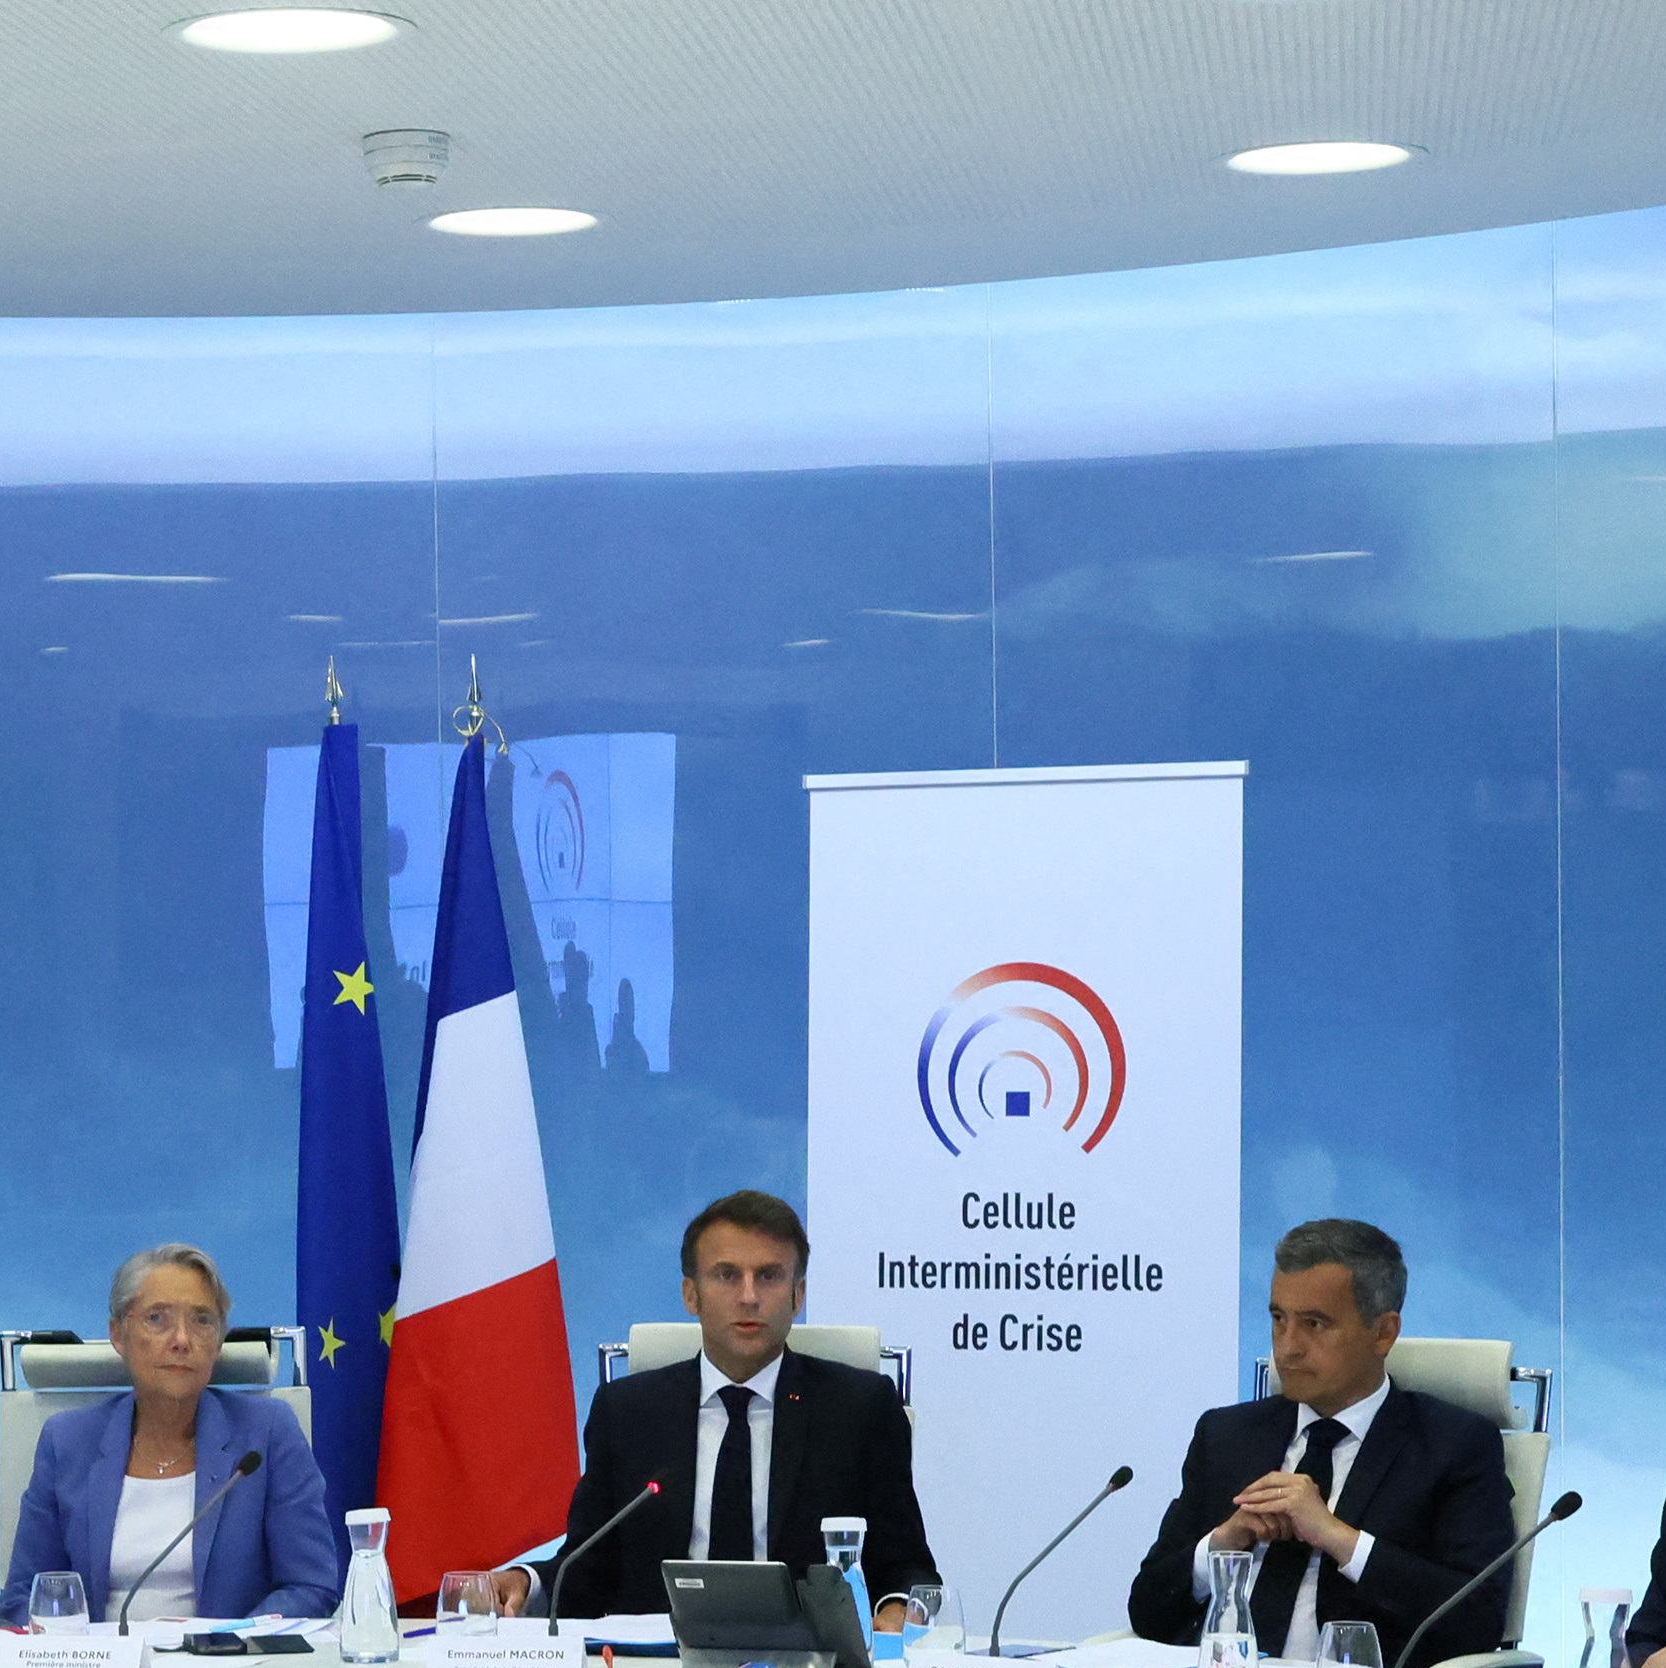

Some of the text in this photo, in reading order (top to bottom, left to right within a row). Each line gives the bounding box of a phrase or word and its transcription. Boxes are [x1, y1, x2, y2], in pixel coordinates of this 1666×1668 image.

[962, 1192, 1076, 1230] Cellule
[878, 1251, 1164, 1292] Interministérielle
[952, 1313, 1083, 1352] de Crise
[26, 1660, 101, 1668] Première ministre
[72, 1650, 112, 1660] BORNE
[447, 1650, 564, 1660] Emmanuel MACRON
